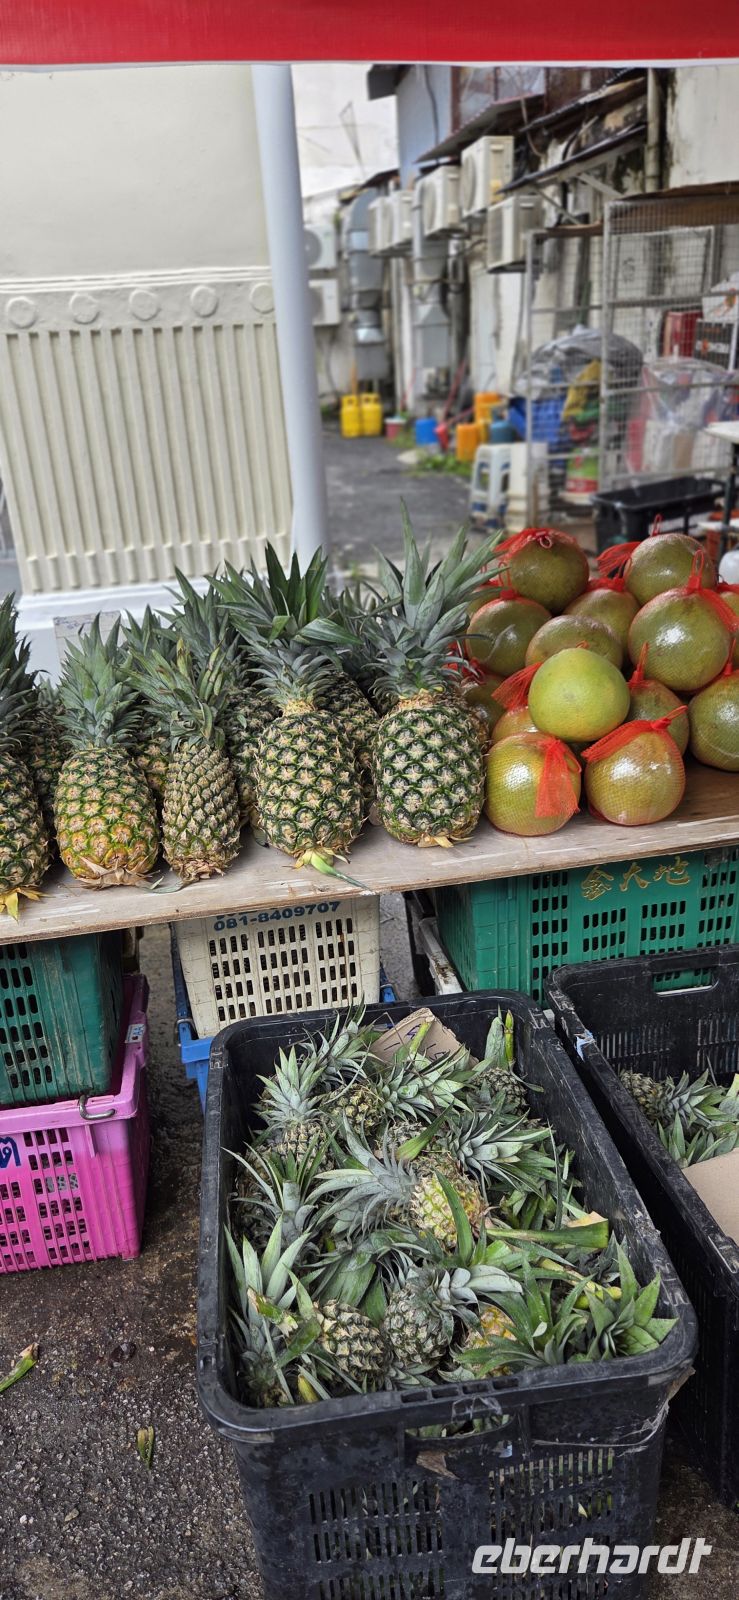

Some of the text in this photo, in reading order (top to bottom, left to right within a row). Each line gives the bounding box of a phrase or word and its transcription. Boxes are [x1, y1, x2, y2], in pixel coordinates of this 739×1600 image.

[581, 856, 690, 900] 金大地
[213, 901, 340, 931] 081-8409707
